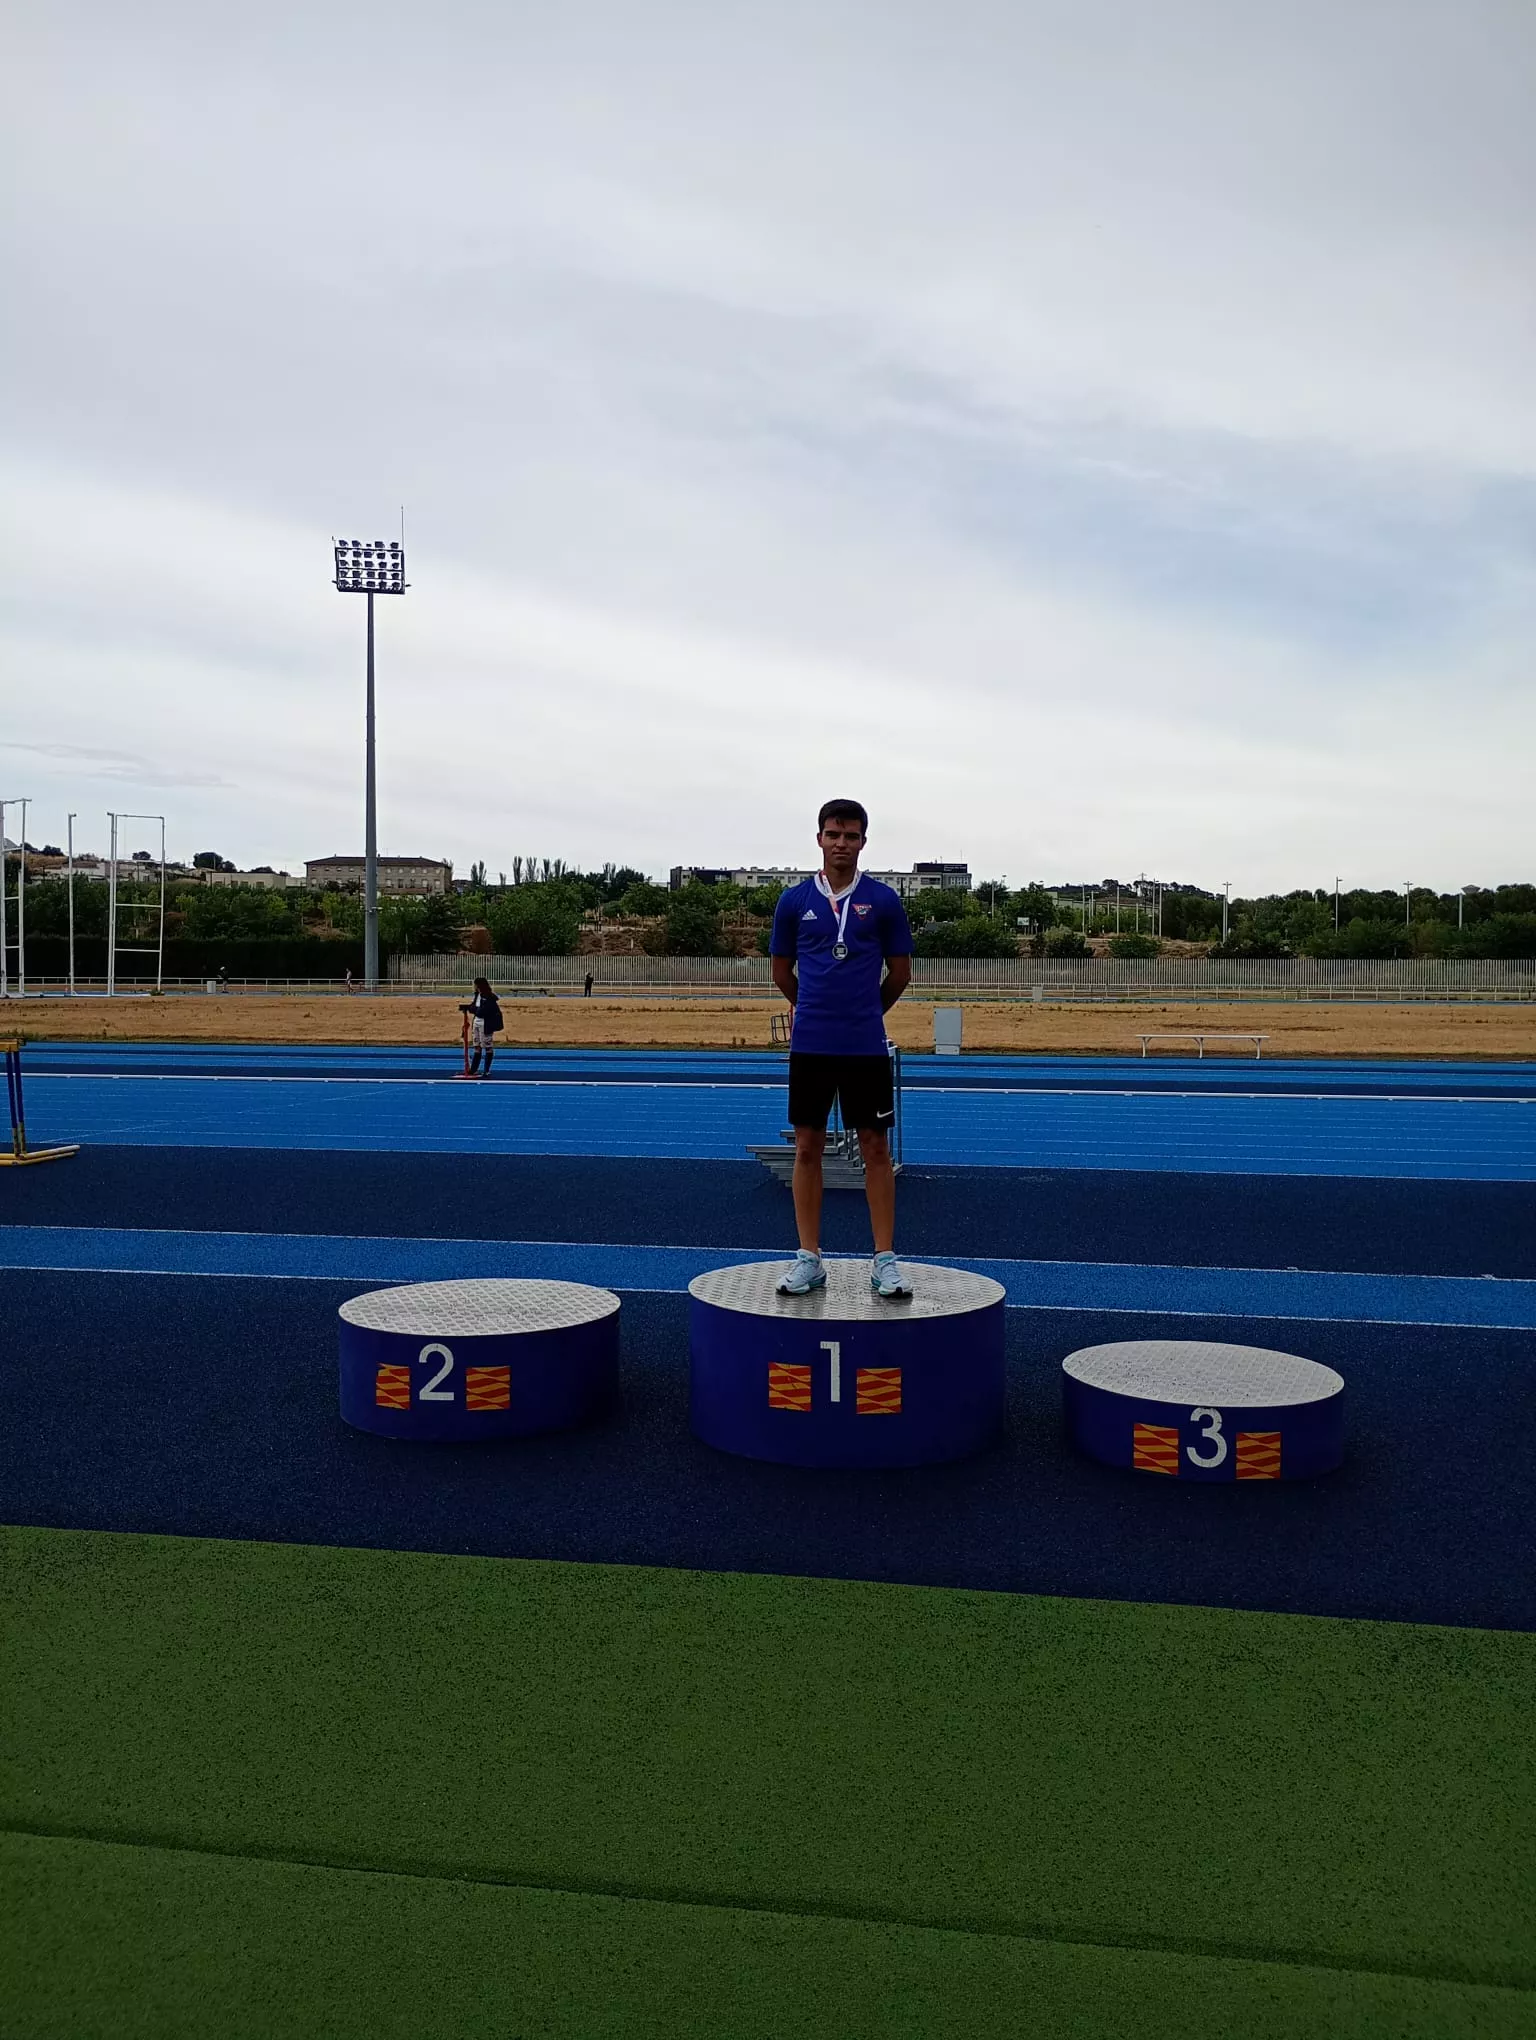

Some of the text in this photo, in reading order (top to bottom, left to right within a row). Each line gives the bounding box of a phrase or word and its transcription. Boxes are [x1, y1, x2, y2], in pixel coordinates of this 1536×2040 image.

[418, 1343, 455, 1401] 2
[820, 1341, 841, 1402] 1
[1186, 1407, 1228, 1468] 3
